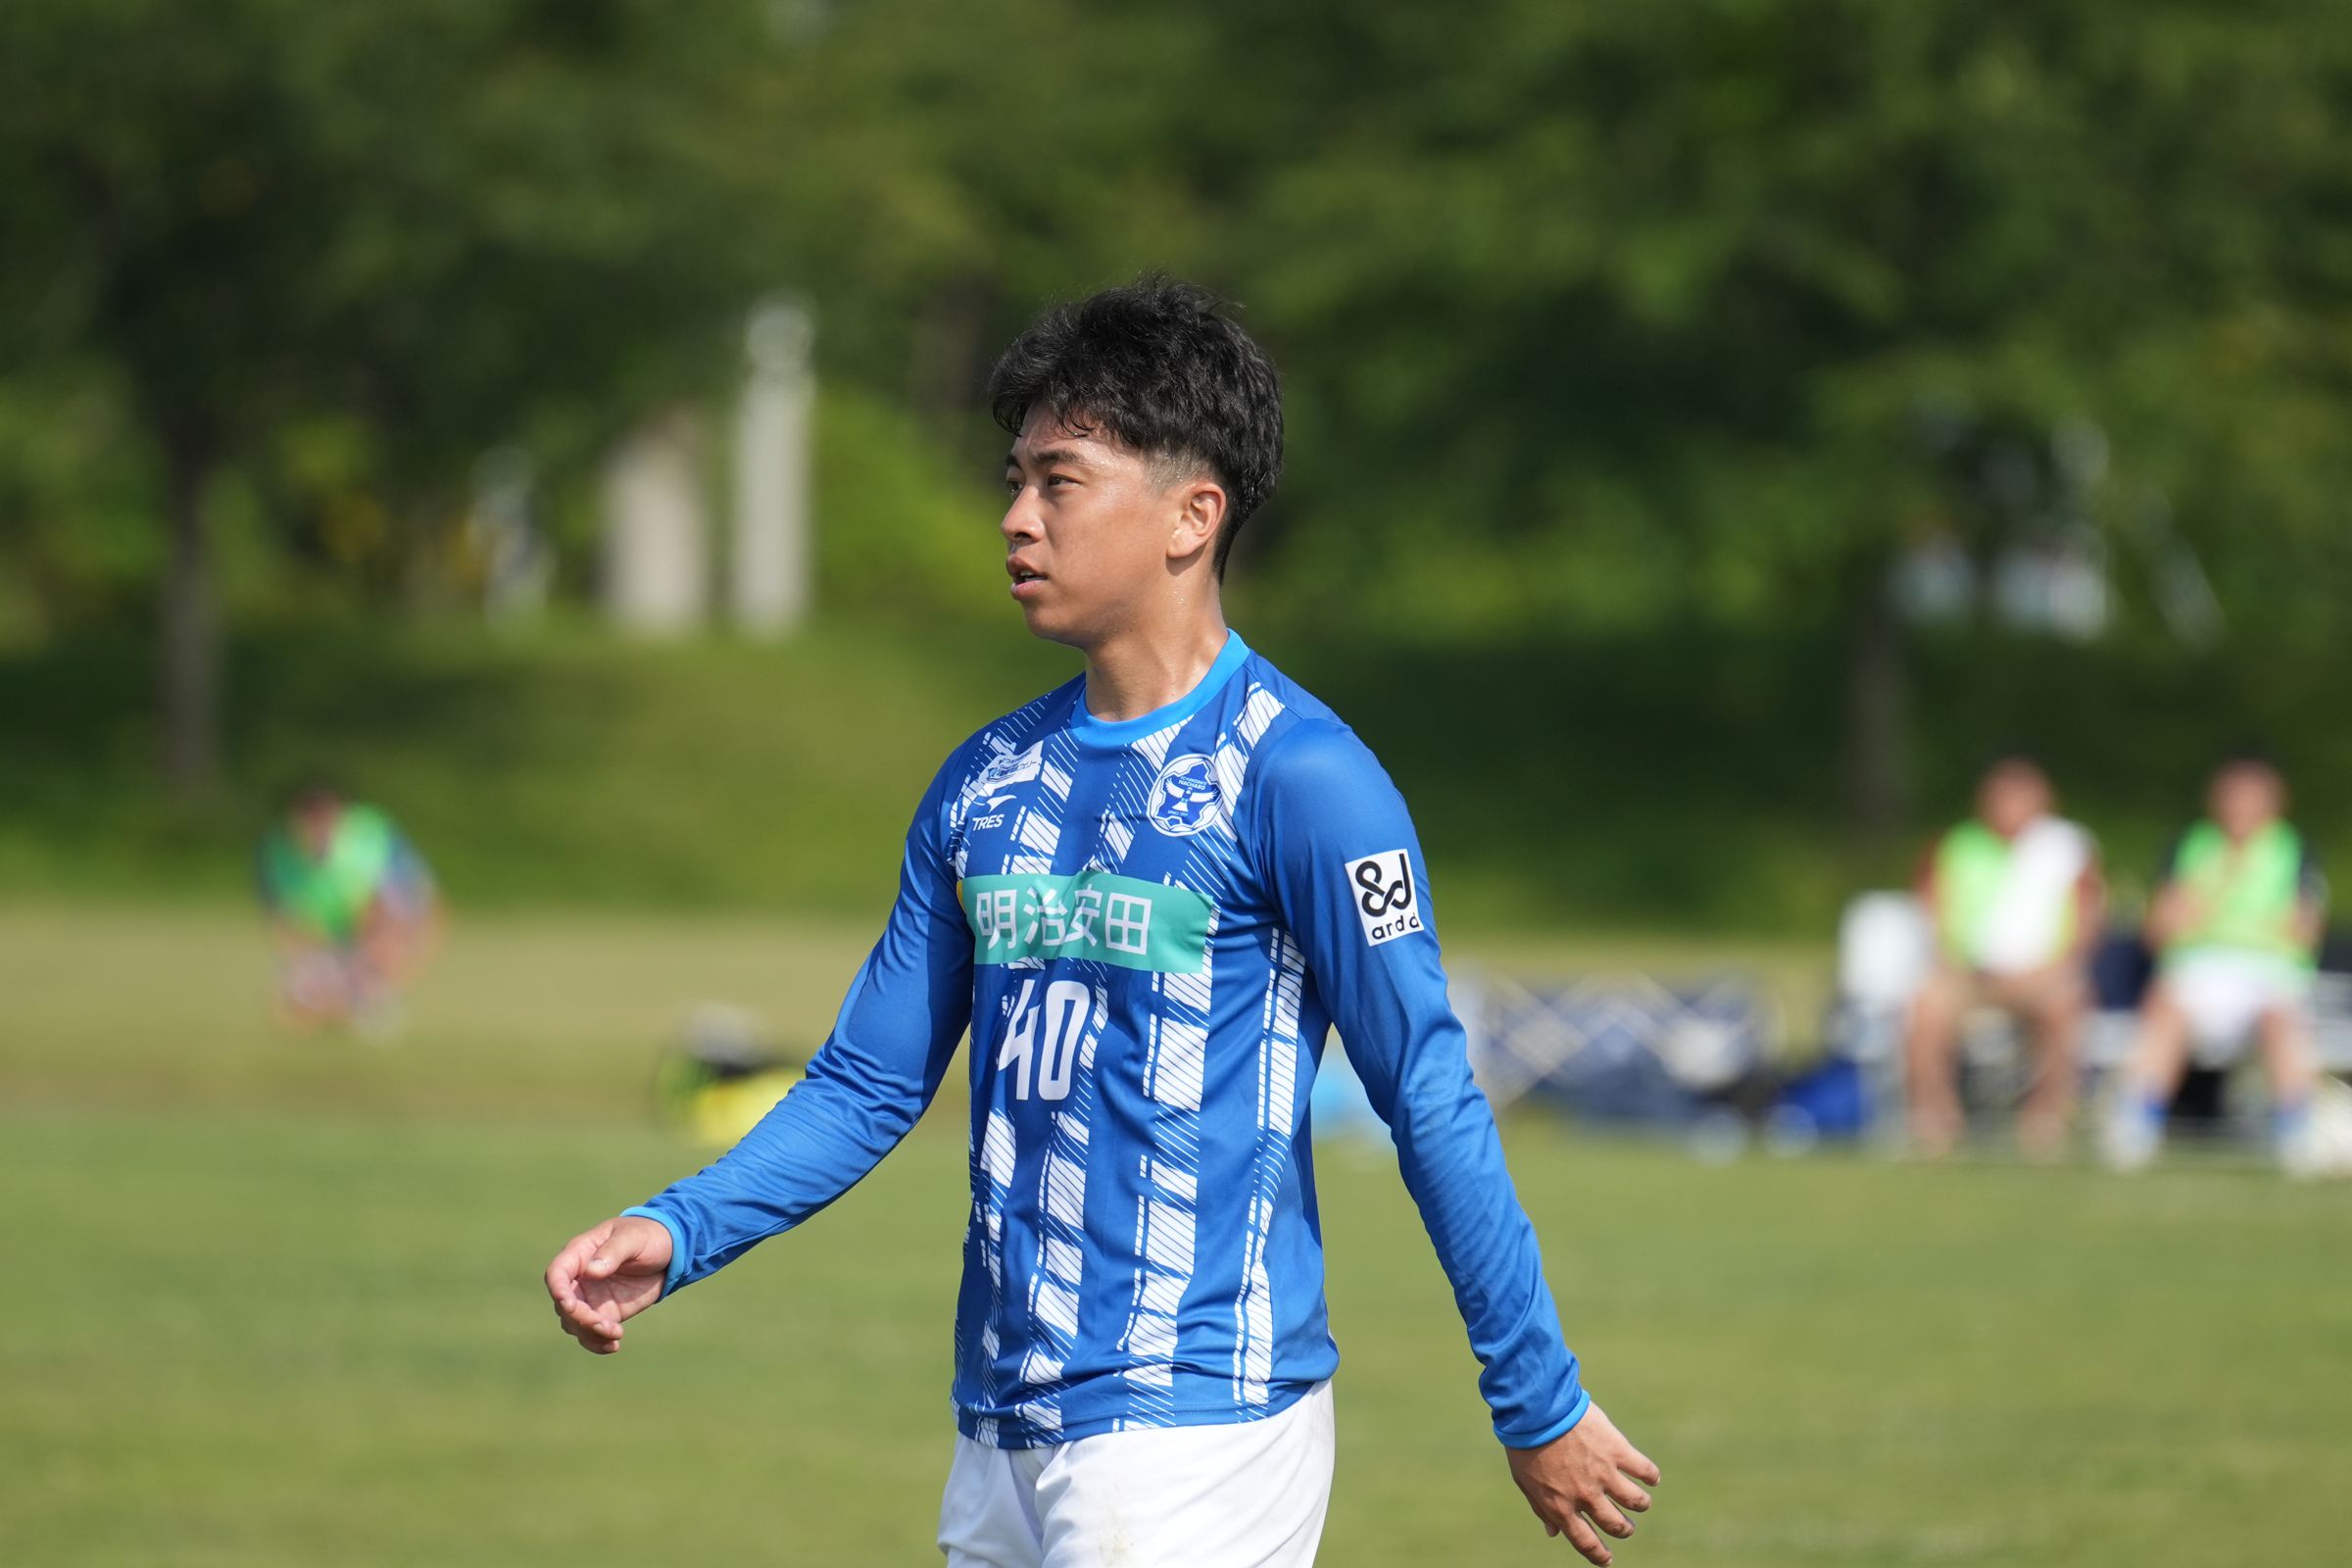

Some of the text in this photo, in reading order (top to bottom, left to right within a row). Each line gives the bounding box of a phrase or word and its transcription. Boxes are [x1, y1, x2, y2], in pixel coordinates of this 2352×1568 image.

[972, 813, 1005, 831] TRES
[976, 884, 1152, 956] 明治安田
[998, 979, 1091, 1102] 40
